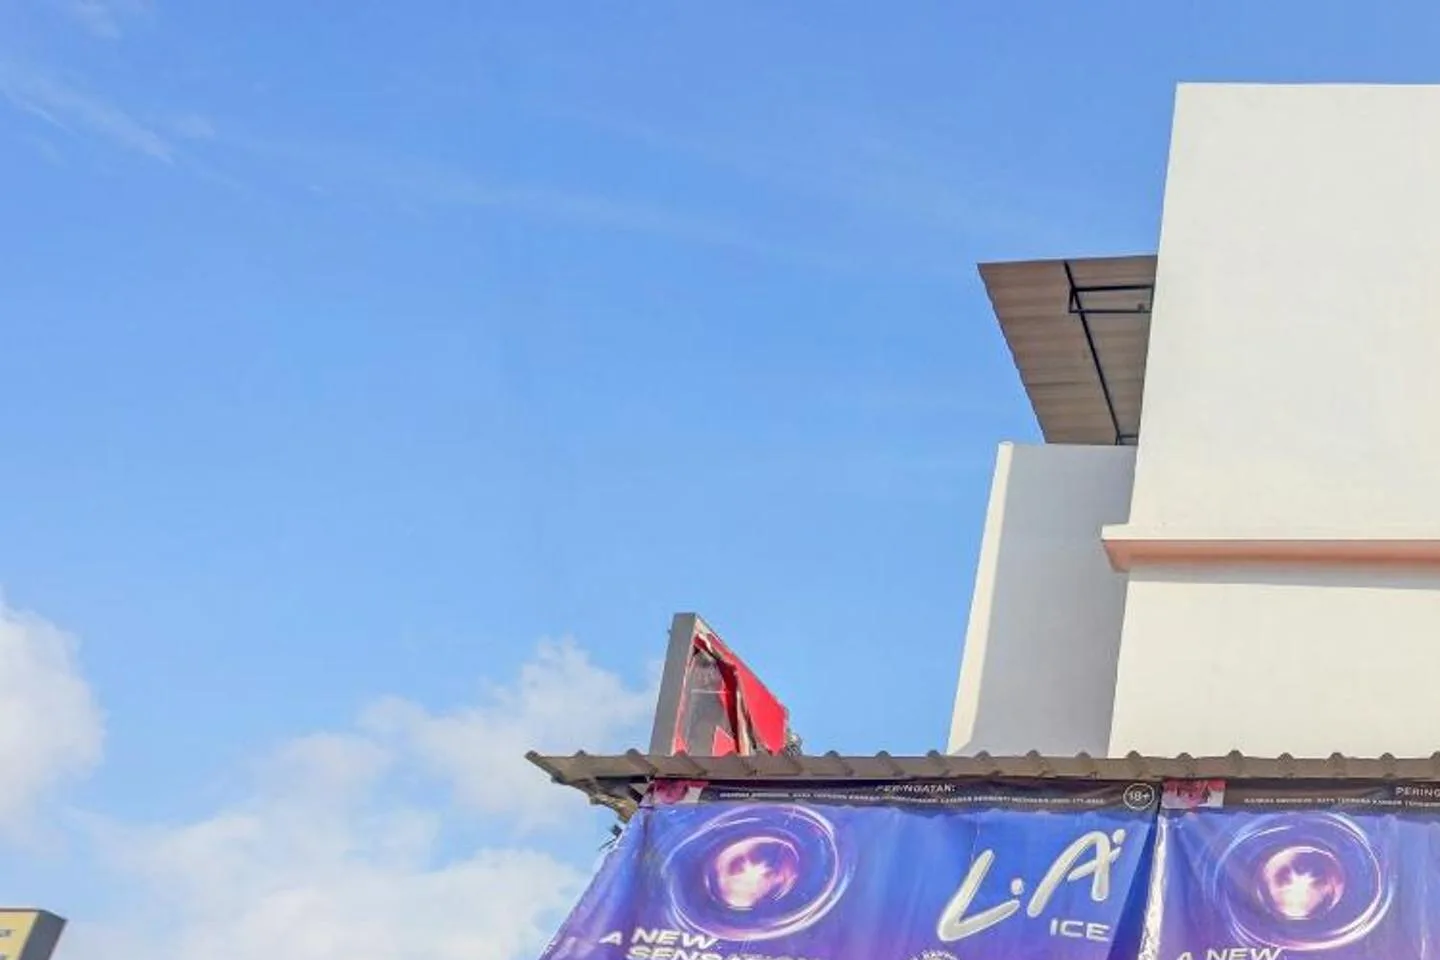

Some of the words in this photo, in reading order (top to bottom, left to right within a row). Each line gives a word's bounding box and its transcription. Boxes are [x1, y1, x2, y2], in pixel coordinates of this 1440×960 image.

[599, 931, 622, 946] A
[631, 927, 718, 949] NEW
[1051, 918, 1111, 941] ICE
